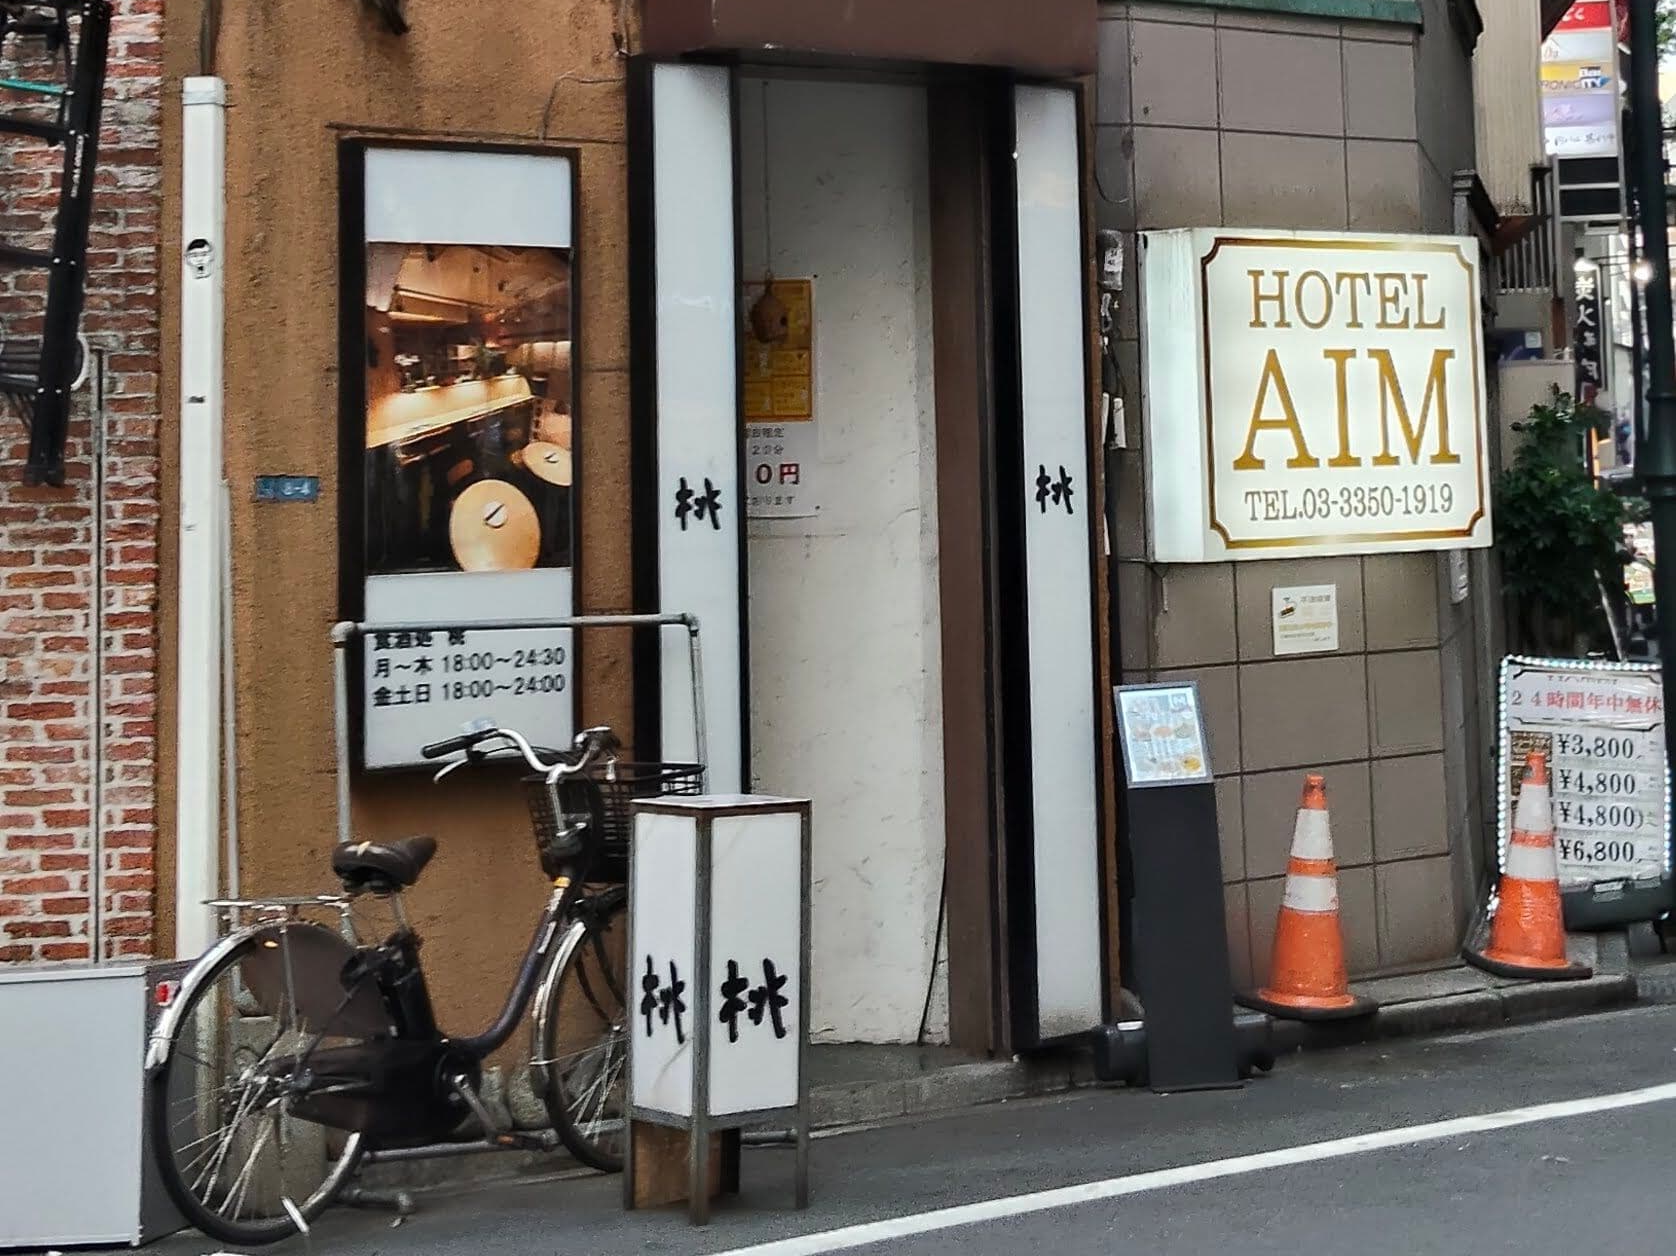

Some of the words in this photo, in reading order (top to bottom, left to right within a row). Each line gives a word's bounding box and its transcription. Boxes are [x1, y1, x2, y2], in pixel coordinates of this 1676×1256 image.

[1247, 269, 1446, 330] HOTEL
[1233, 348, 1461, 471] AIM
[1244, 483, 1454, 522] TEL.03-3350-1919
[373, 683, 432, 707] 金土日
[1557, 733, 1634, 759] ¥3,800
[1559, 768, 1636, 795] ¥4,800
[1559, 838, 1635, 863] ¥6,800
